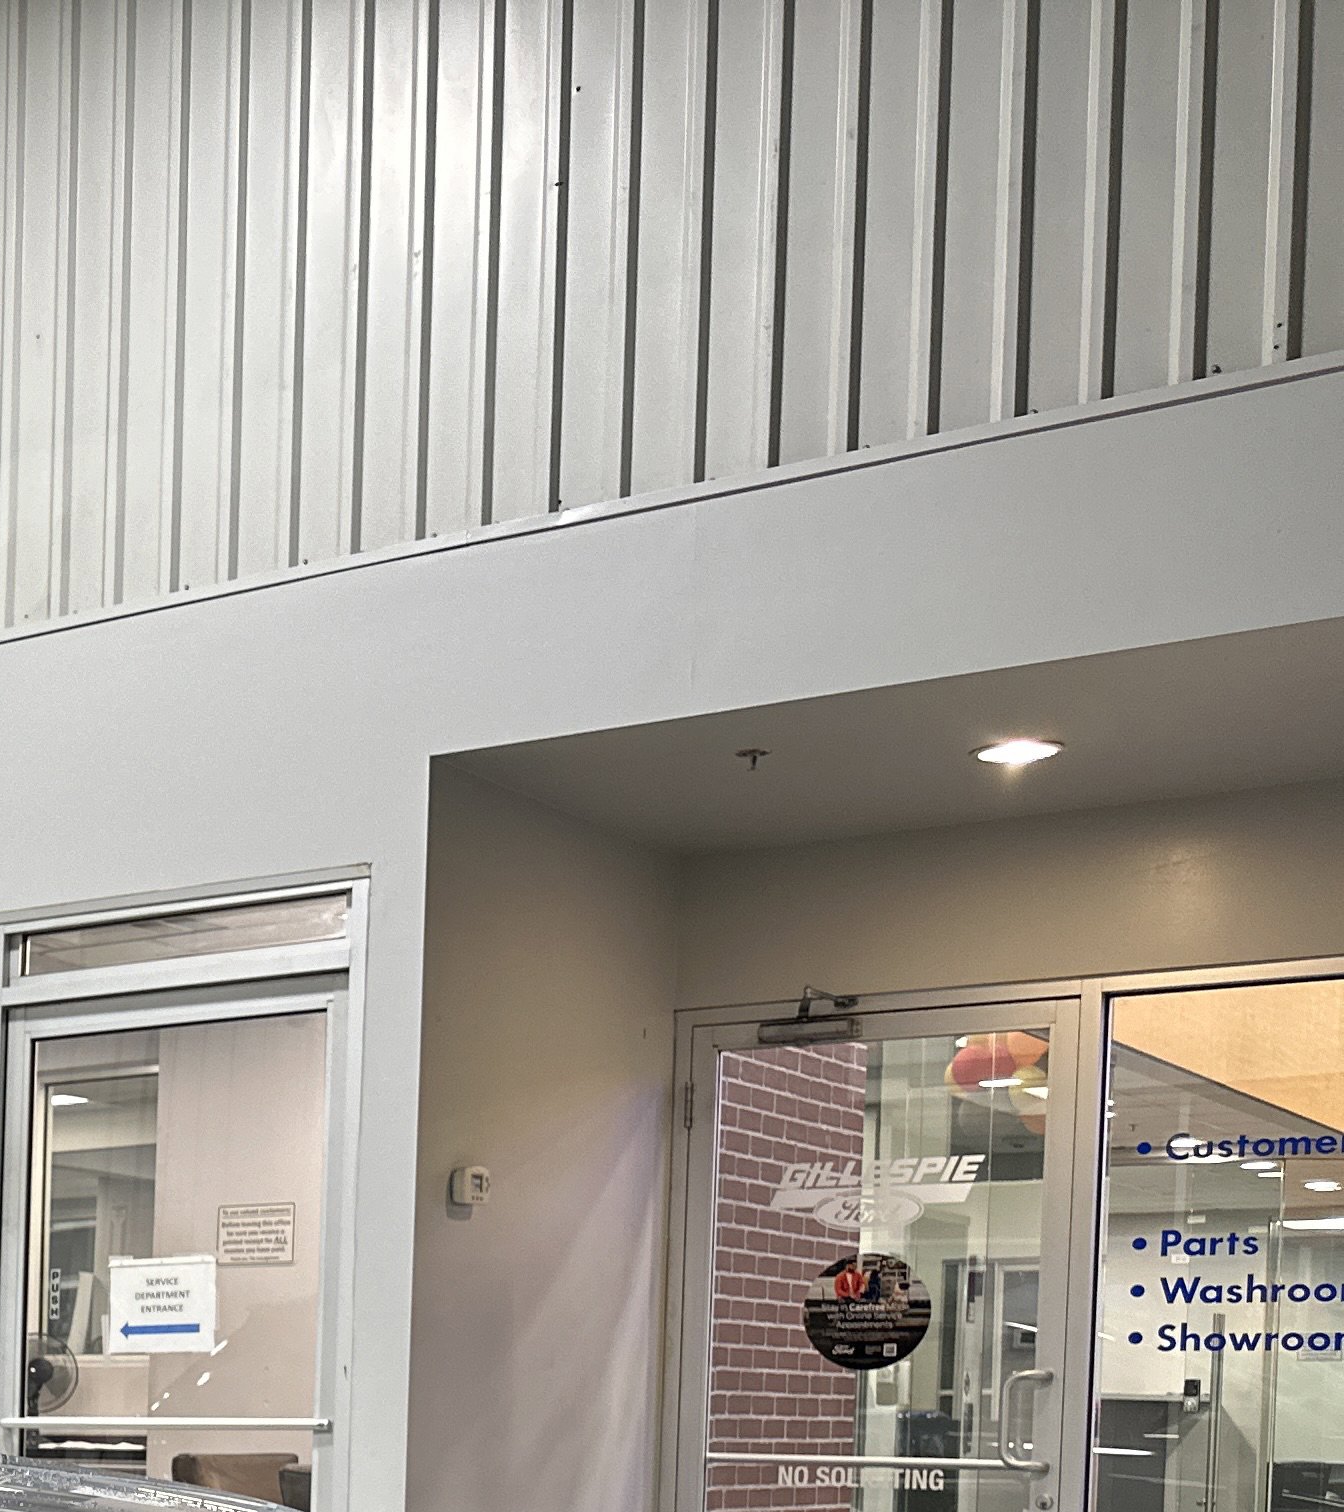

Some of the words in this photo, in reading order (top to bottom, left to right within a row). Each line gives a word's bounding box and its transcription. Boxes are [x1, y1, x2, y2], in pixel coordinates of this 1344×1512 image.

[1166, 1132, 1344, 1160] Custome
[780, 1154, 986, 1188] GILLESPIE
[1160, 1229, 1260, 1257] Parts
[50, 1271, 60, 1317] PUSH
[134, 1289, 191, 1301] DEPARTMENT
[145, 1277, 179, 1287] SERVICE
[1160, 1274, 1344, 1304] Washroo
[140, 1303, 184, 1313] ENTRANCE
[778, 1465, 809, 1488] NO
[816, 1466, 945, 1492] SOLITING
